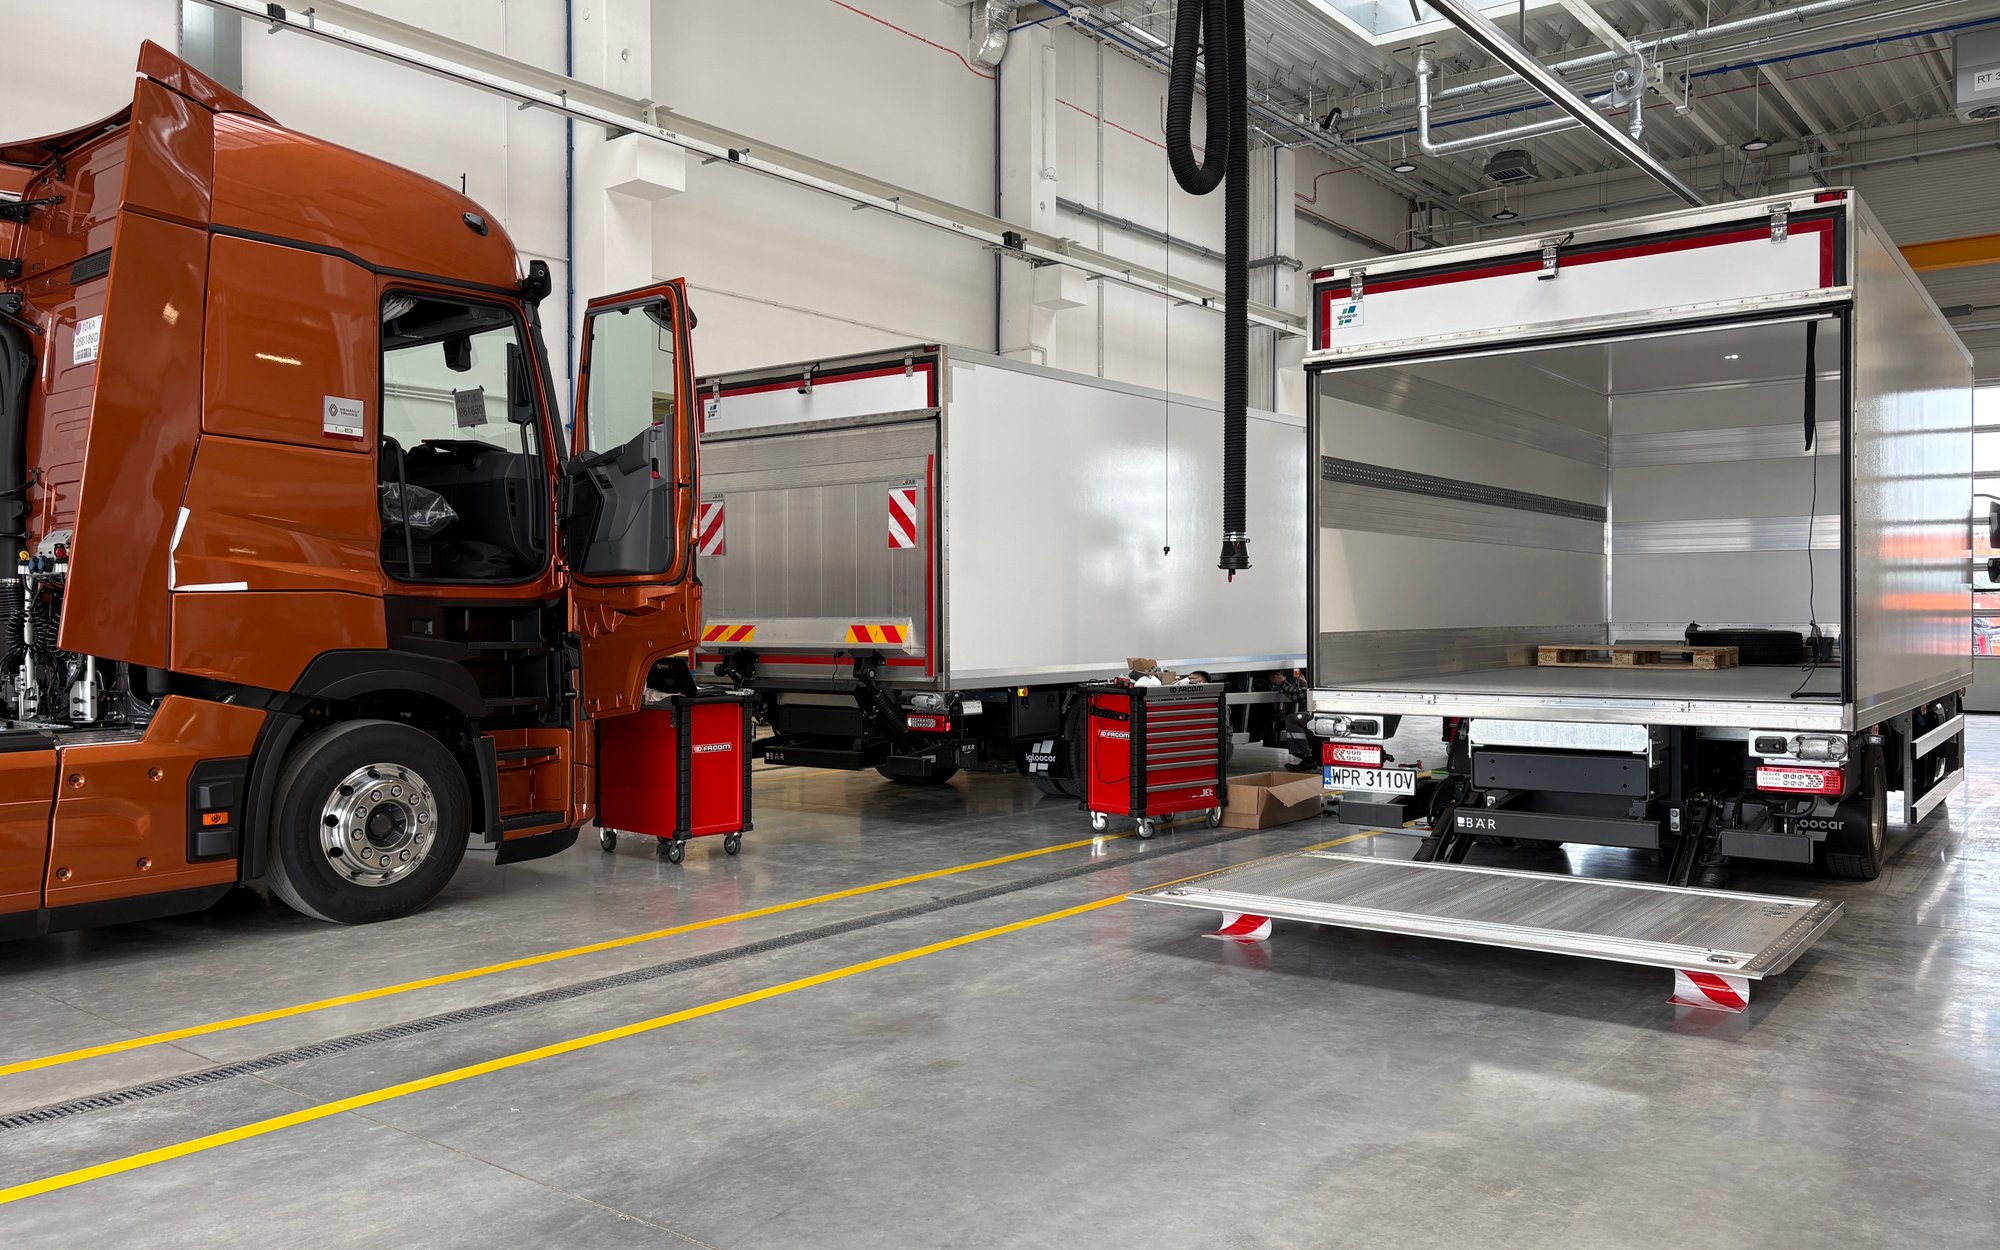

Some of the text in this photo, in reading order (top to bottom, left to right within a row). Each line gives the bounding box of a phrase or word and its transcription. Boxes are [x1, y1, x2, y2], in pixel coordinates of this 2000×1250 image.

[1977, 73, 1992, 84] RT
[1178, 685, 1204, 693] FACOM
[703, 743, 731, 752] FACOM
[1025, 752, 1056, 763] igloocar
[1332, 768, 1360, 786] WPR
[1366, 770, 1413, 790] 3110V
[1466, 816, 1496, 830] BÄR
